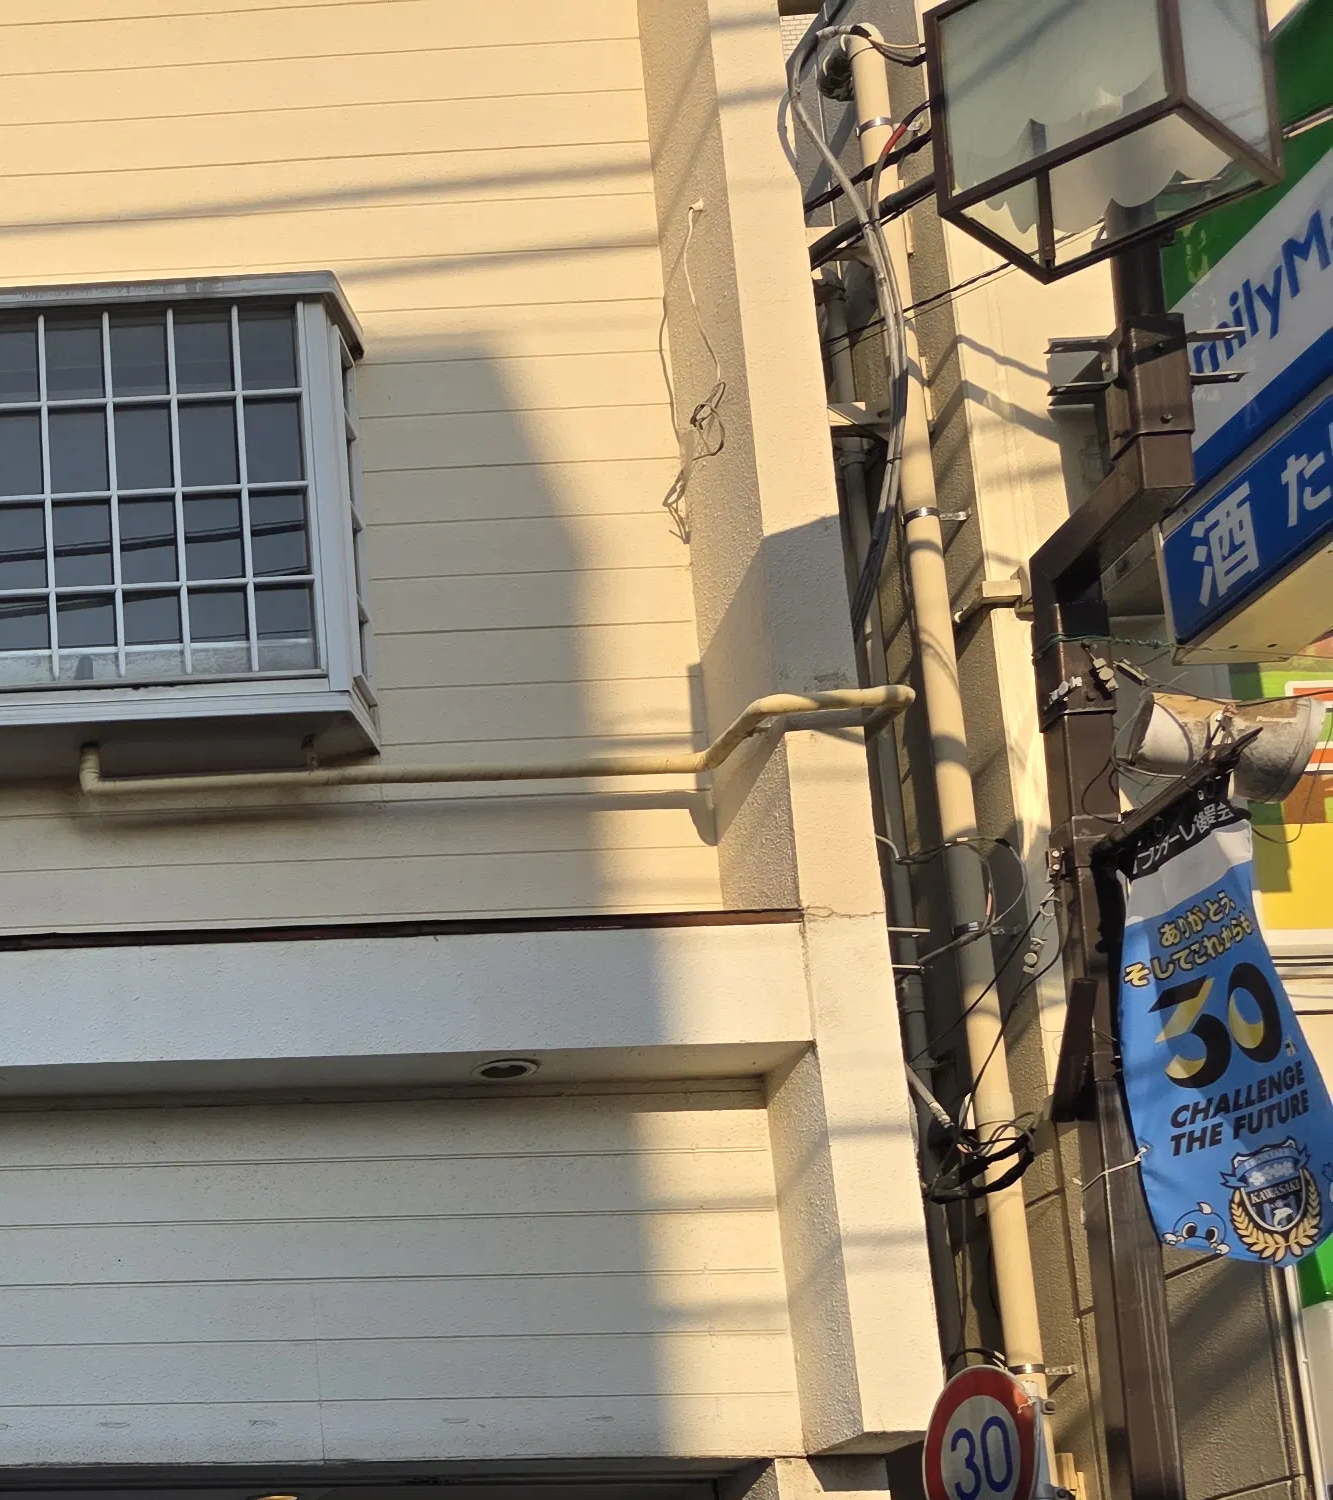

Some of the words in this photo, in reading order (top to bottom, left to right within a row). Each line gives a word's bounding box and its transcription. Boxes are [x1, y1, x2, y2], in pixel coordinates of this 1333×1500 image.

[1191, 481, 1260, 606] 酒
[1280, 422, 1333, 528] た
[1123, 912, 1253, 986] そしてこれからも
[1148, 961, 1282, 1088] 30
[1170, 1060, 1305, 1129] CHALLENGE
[1170, 1122, 1223, 1157] THE
[1233, 1089, 1310, 1140] FUTURE
[1250, 1179, 1301, 1203] KAWASAKI
